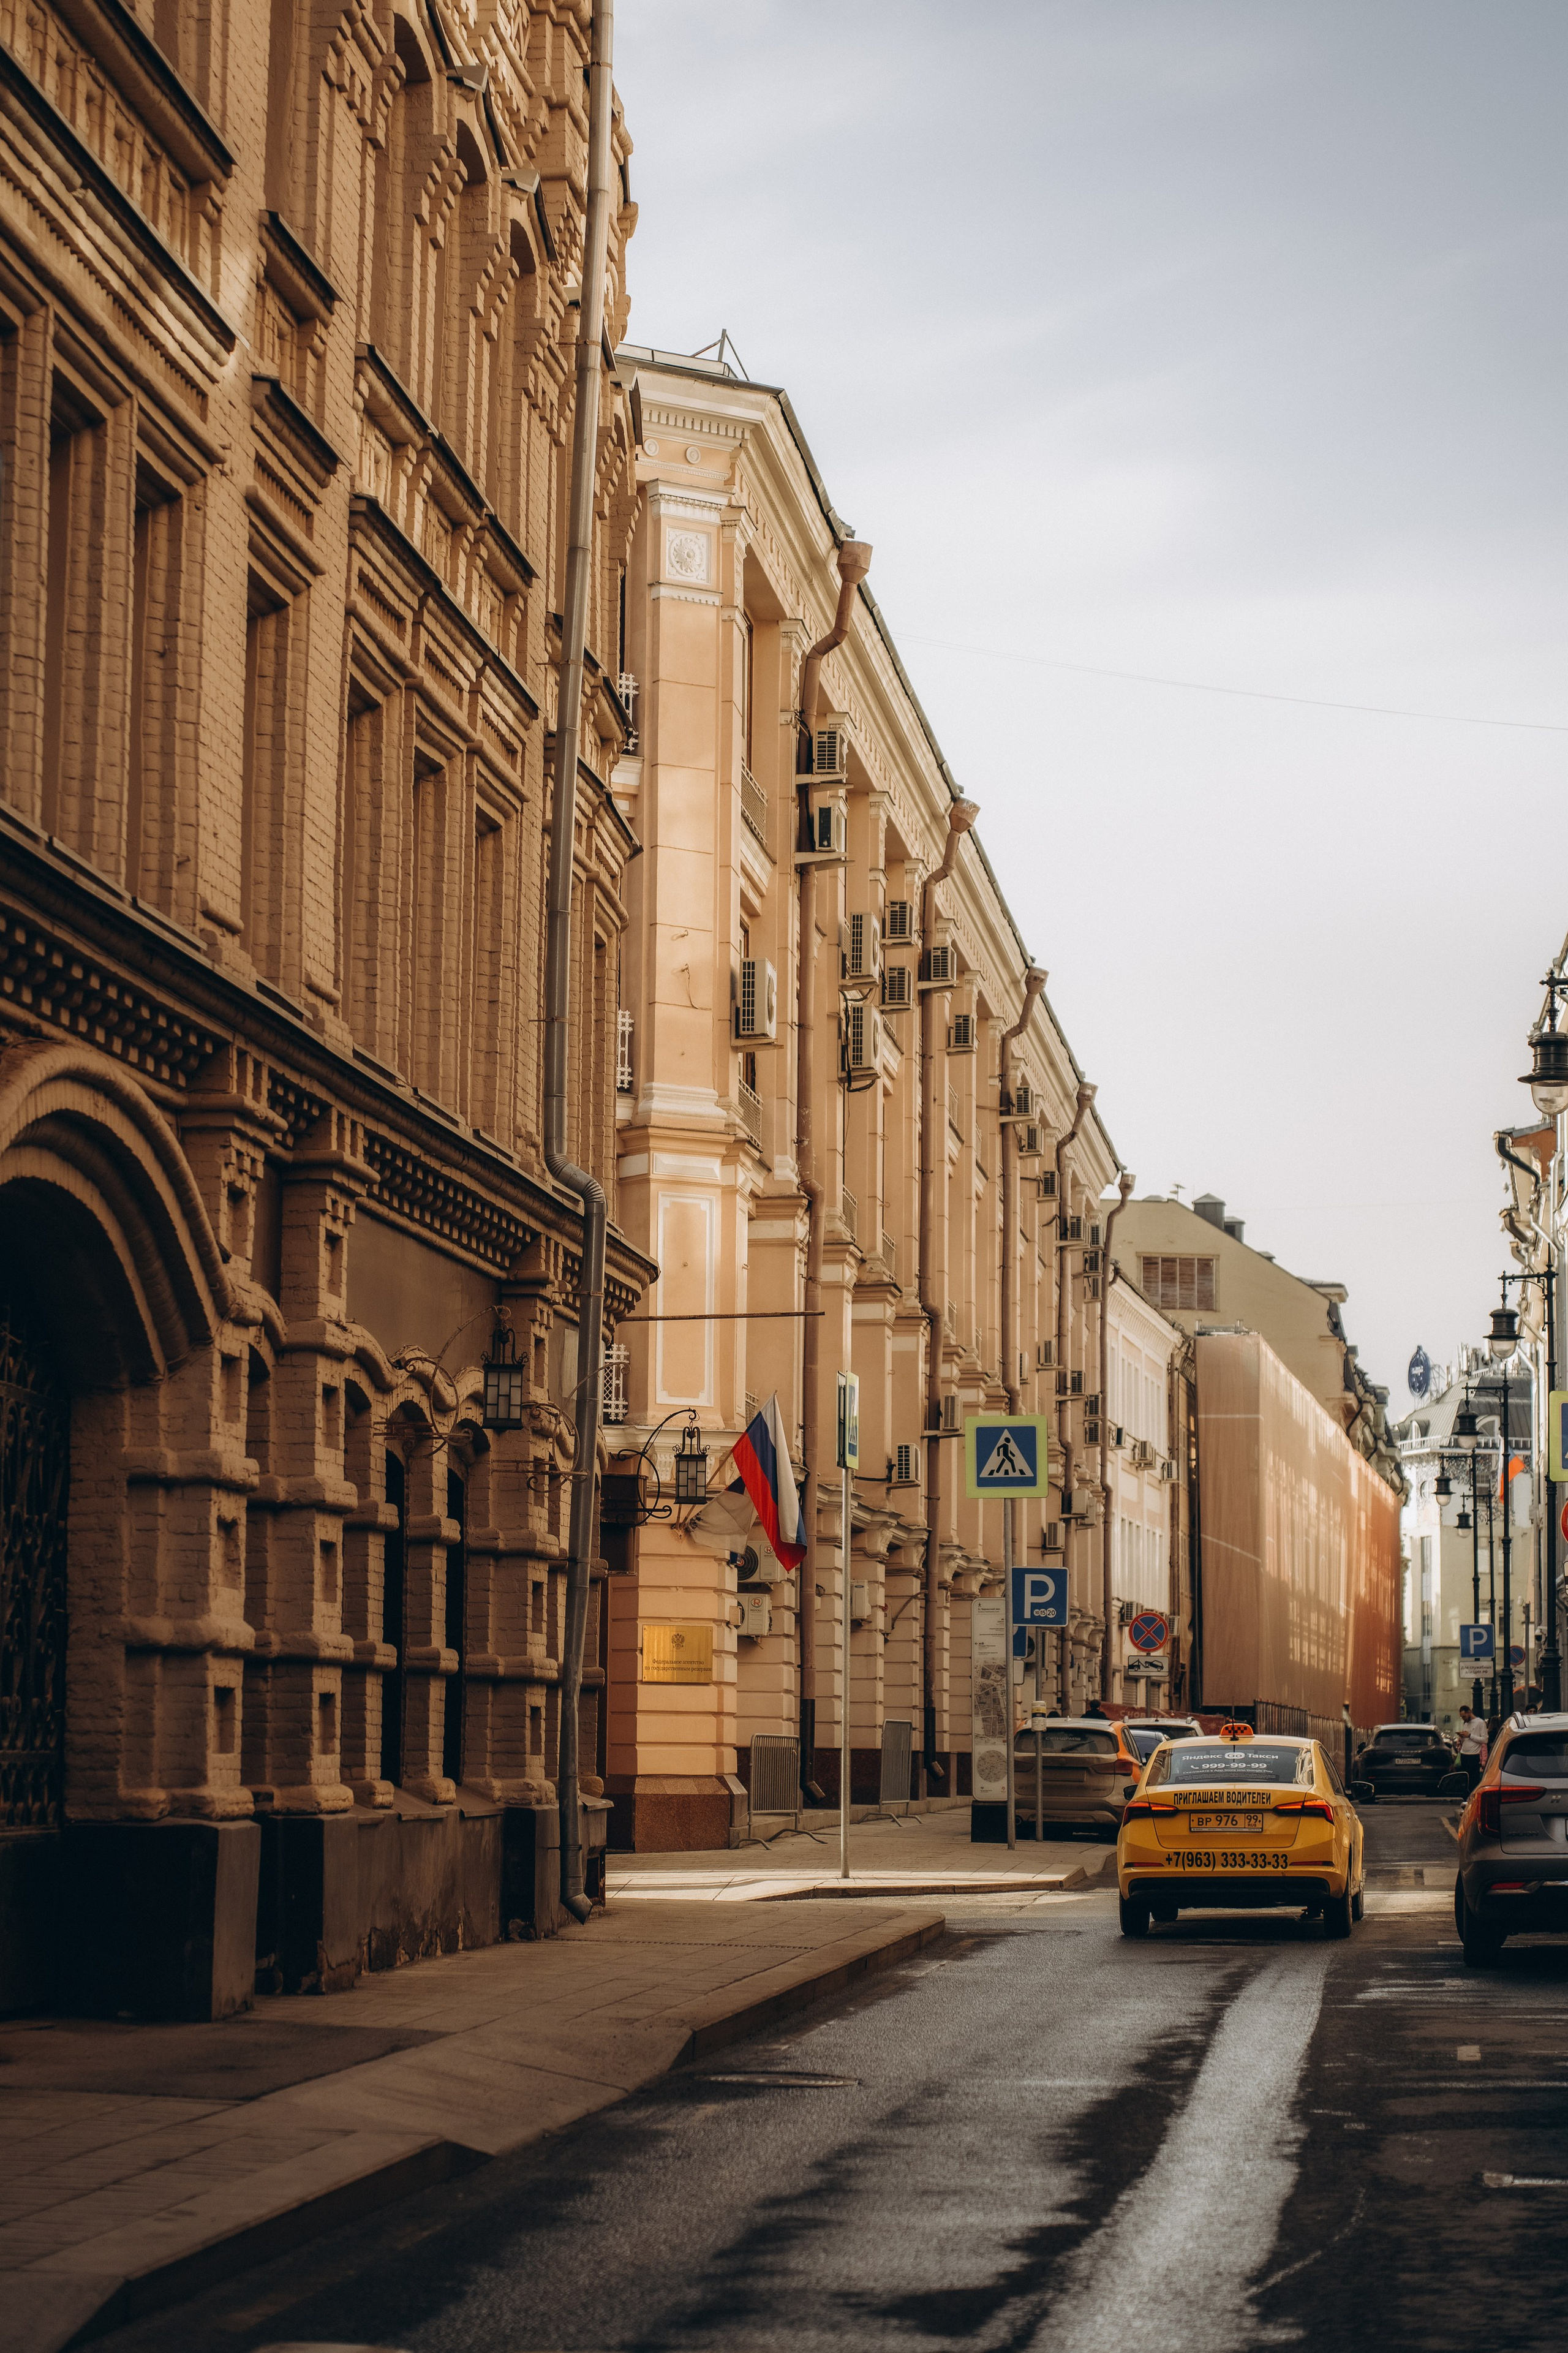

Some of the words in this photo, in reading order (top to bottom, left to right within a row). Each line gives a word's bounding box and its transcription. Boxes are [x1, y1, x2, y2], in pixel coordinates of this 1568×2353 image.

[1025, 1574, 1055, 1618] P
[1469, 1628, 1488, 1654] P
[1174, 1791, 1224, 1805] ПРИГЛАШАЕМ
[1215, 1815, 1238, 1827] 976
[1246, 1815, 1259, 1823] 99
[1165, 1851, 1216, 1871] +7(963)
[1220, 1852, 1288, 1870] 333-33-33
